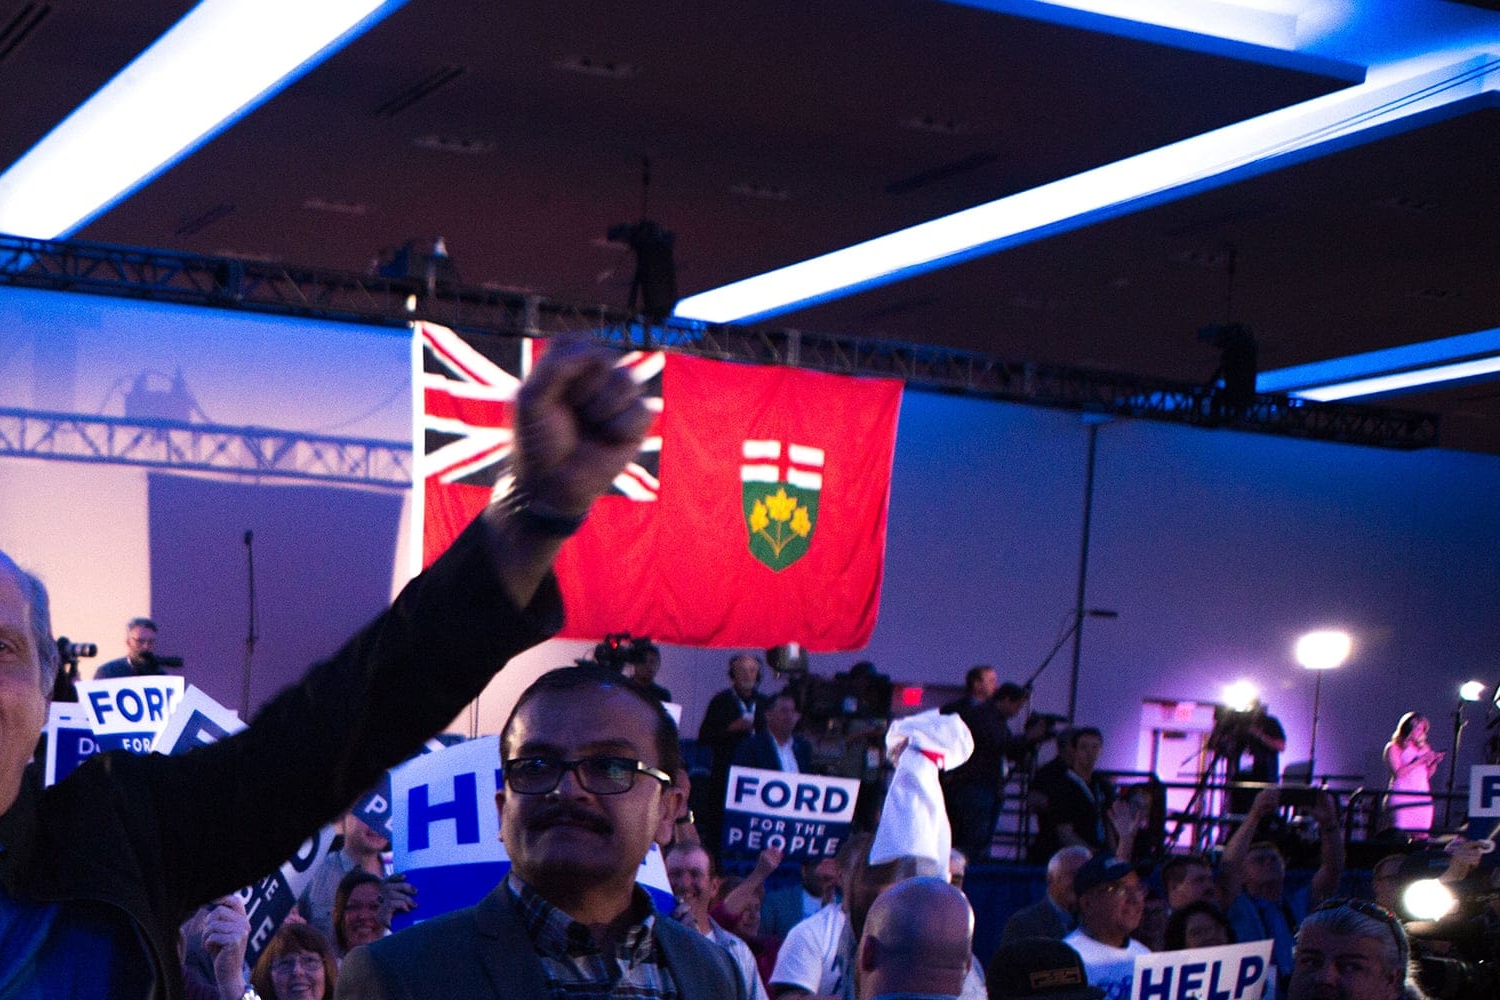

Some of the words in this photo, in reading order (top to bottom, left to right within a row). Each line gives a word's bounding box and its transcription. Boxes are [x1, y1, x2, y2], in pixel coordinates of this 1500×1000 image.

[735, 776, 849, 813] FORD
[750, 817, 786, 832] FOR
[794, 822, 826, 836] THE
[728, 827, 841, 856] PEOPLE
